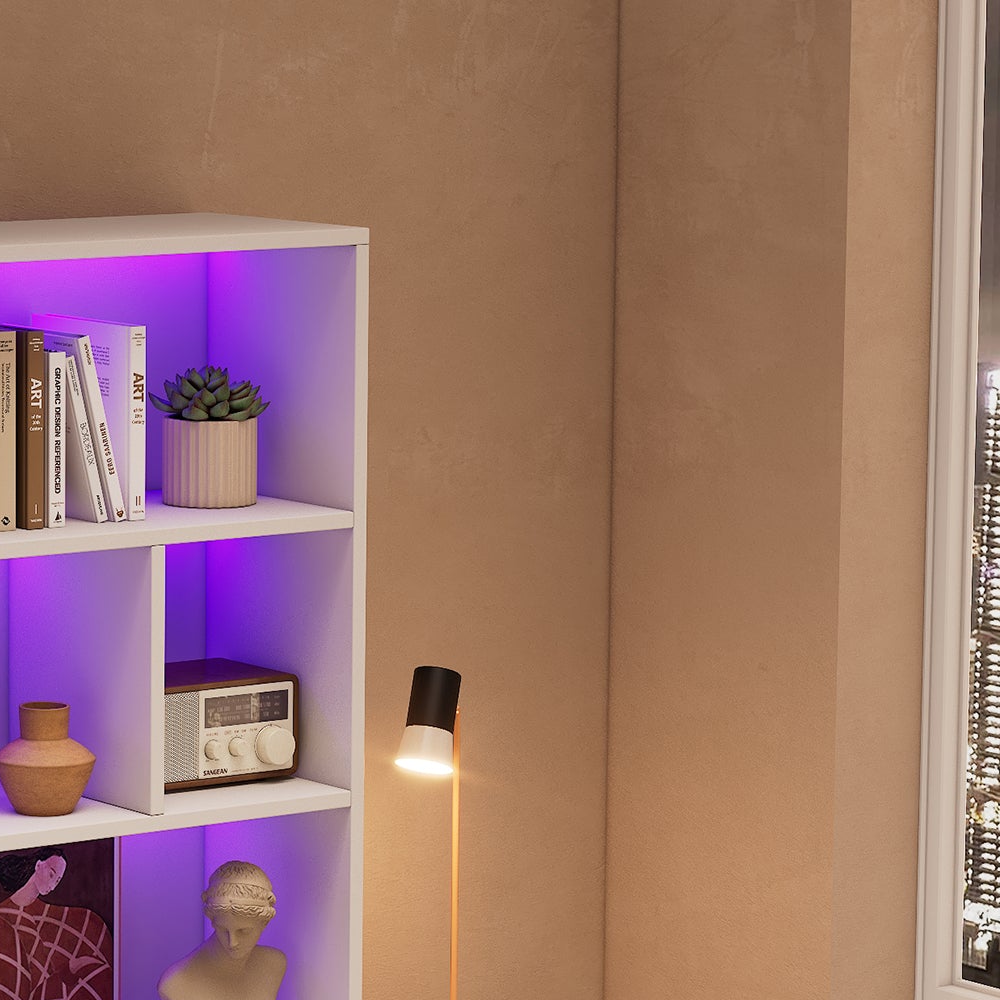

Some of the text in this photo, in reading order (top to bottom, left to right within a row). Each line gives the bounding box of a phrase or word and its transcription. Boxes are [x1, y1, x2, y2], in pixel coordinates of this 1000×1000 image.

[29, 377, 43, 409] ART
[132, 372, 145, 403] ART
[80, 421, 95, 466] BORDEAUX
[99, 421, 112, 457] SAARINEN
[203, 768, 229, 777] SANGEAN
